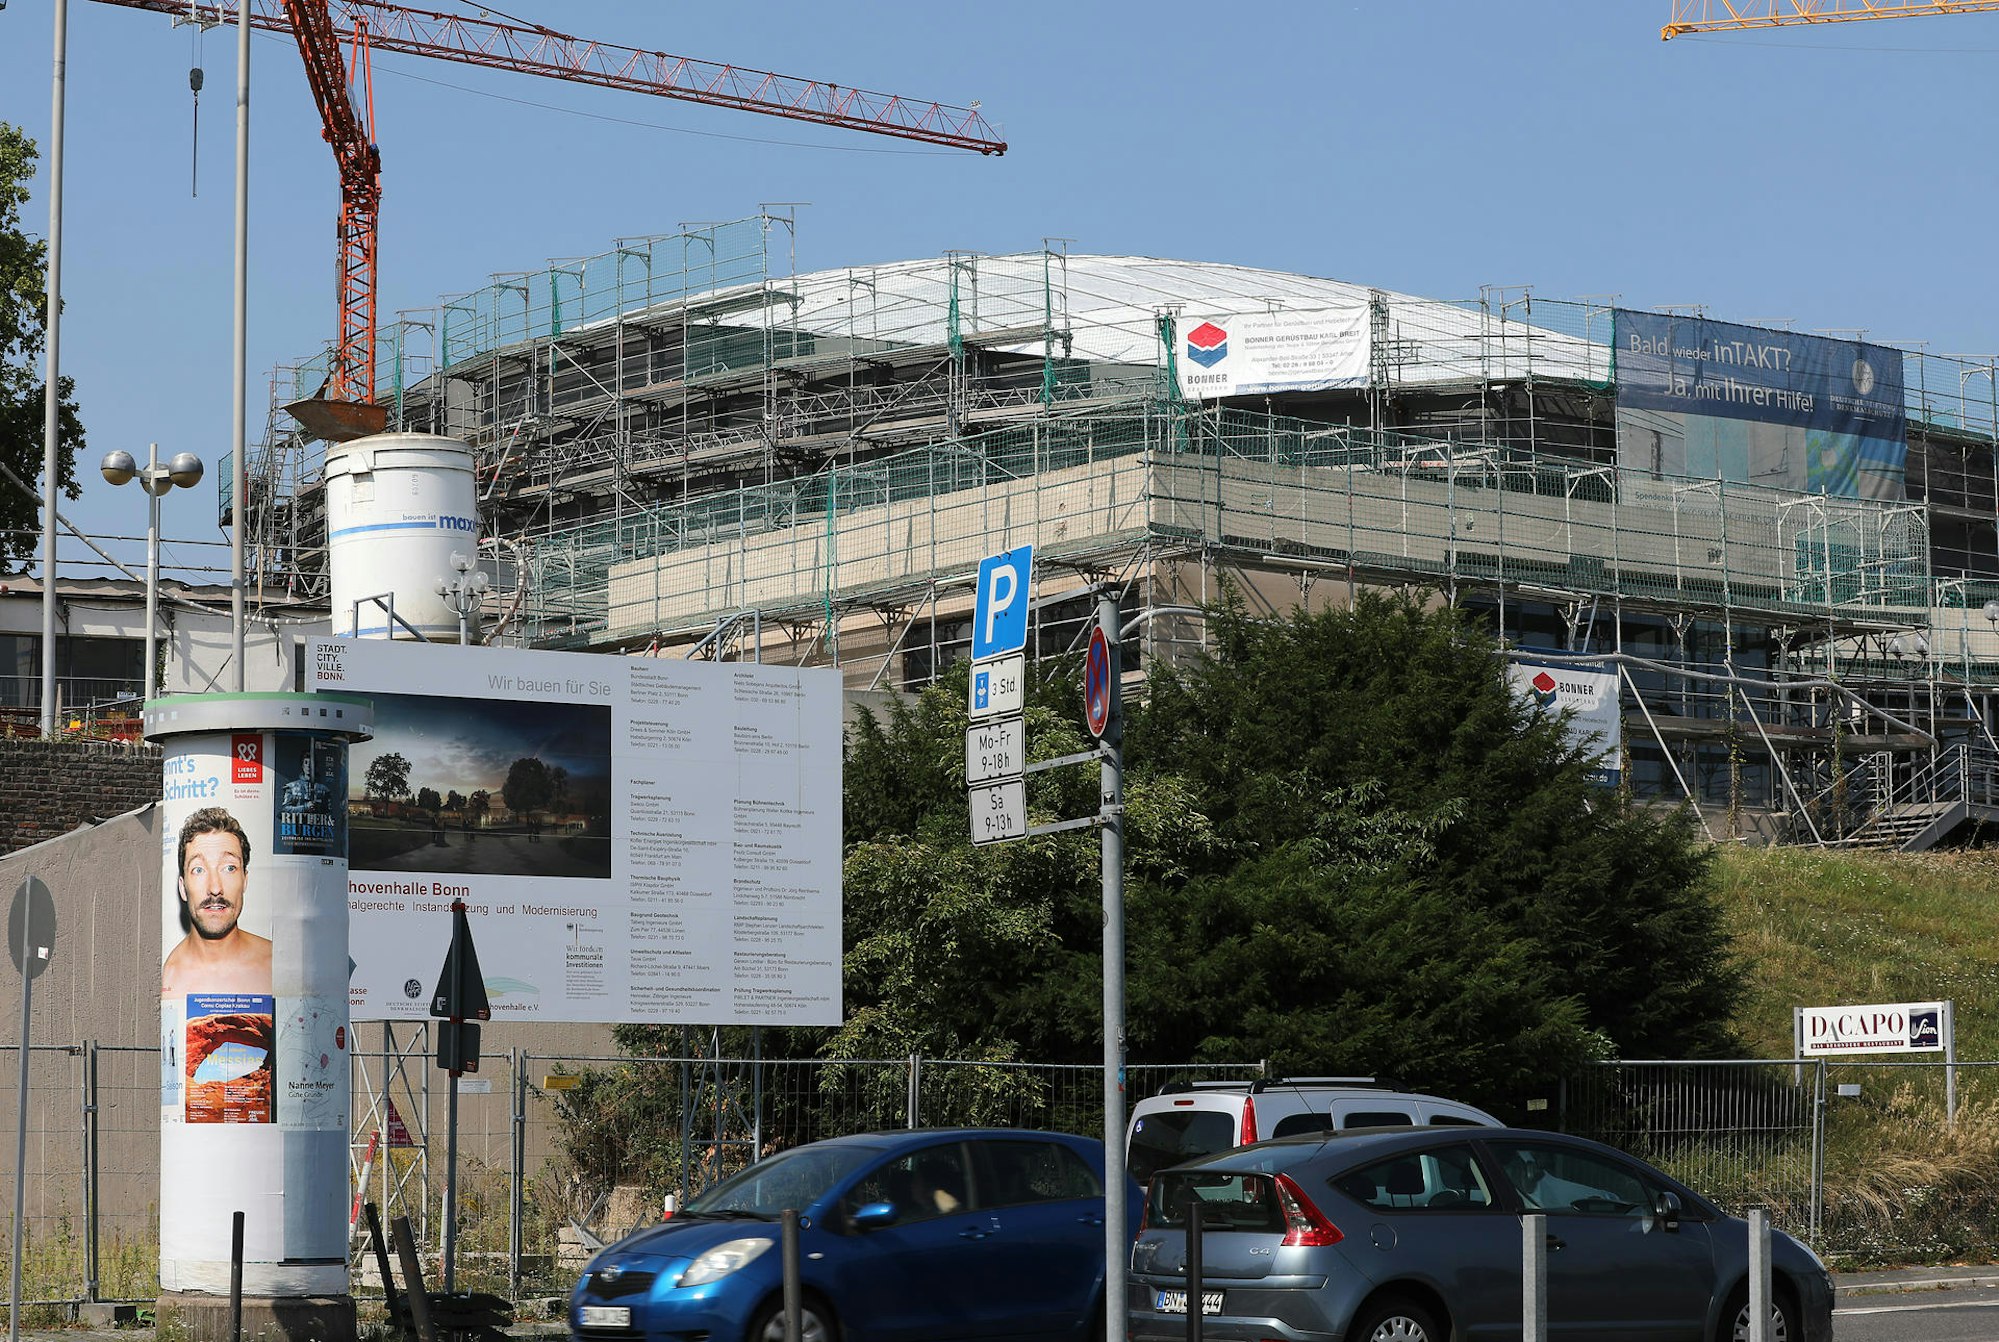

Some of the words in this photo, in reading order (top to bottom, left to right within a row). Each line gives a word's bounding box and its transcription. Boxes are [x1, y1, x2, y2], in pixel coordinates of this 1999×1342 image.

[1245, 336, 1274, 344] BONNER
[1276, 334, 1318, 342] GERÜSTBAU
[1340, 330, 1360, 338] BREIT
[1630, 334, 1669, 356] Bald
[1672, 346, 1711, 361] wieder
[1714, 339, 1791, 372] inTAKT?
[1188, 374, 1228, 384] BONNER
[1664, 376, 1691, 399] Ja,
[1695, 383, 1721, 400] mit
[1725, 378, 1773, 406] Ihrer
[1776, 390, 1814, 412] Hilfe!
[986, 564, 1017, 644] P
[317, 644, 347, 654] STADT.
[317, 654, 338, 662] CITY.
[317, 662, 344, 671] VILLE.
[317, 672, 345, 680] BONN.
[488, 674, 513, 691] Wir
[516, 677, 560, 693] bauen
[565, 679, 584, 694] für
[588, 681, 611, 696] Sie
[992, 682, 996, 696] 3
[1000, 676, 1017, 694] Std.
[1560, 683, 1594, 696] BONNER
[979, 730, 1011, 752] Mo-Fr
[982, 752, 1010, 772] 9-18h
[164, 777, 219, 801] Schritt?
[991, 795, 1004, 810] Sa
[986, 813, 1012, 833] 9-13h
[281, 823, 334, 838] BURGEN
[432, 882, 470, 896] Bonn
[496, 904, 515, 915] und
[522, 904, 598, 919] Modernisierung
[528, 1004, 540, 1012] e.V.
[207, 1054, 264, 1066] Messias
[316, 1082, 334, 1091] Meyer
[1164, 1292, 1178, 1306] BN
